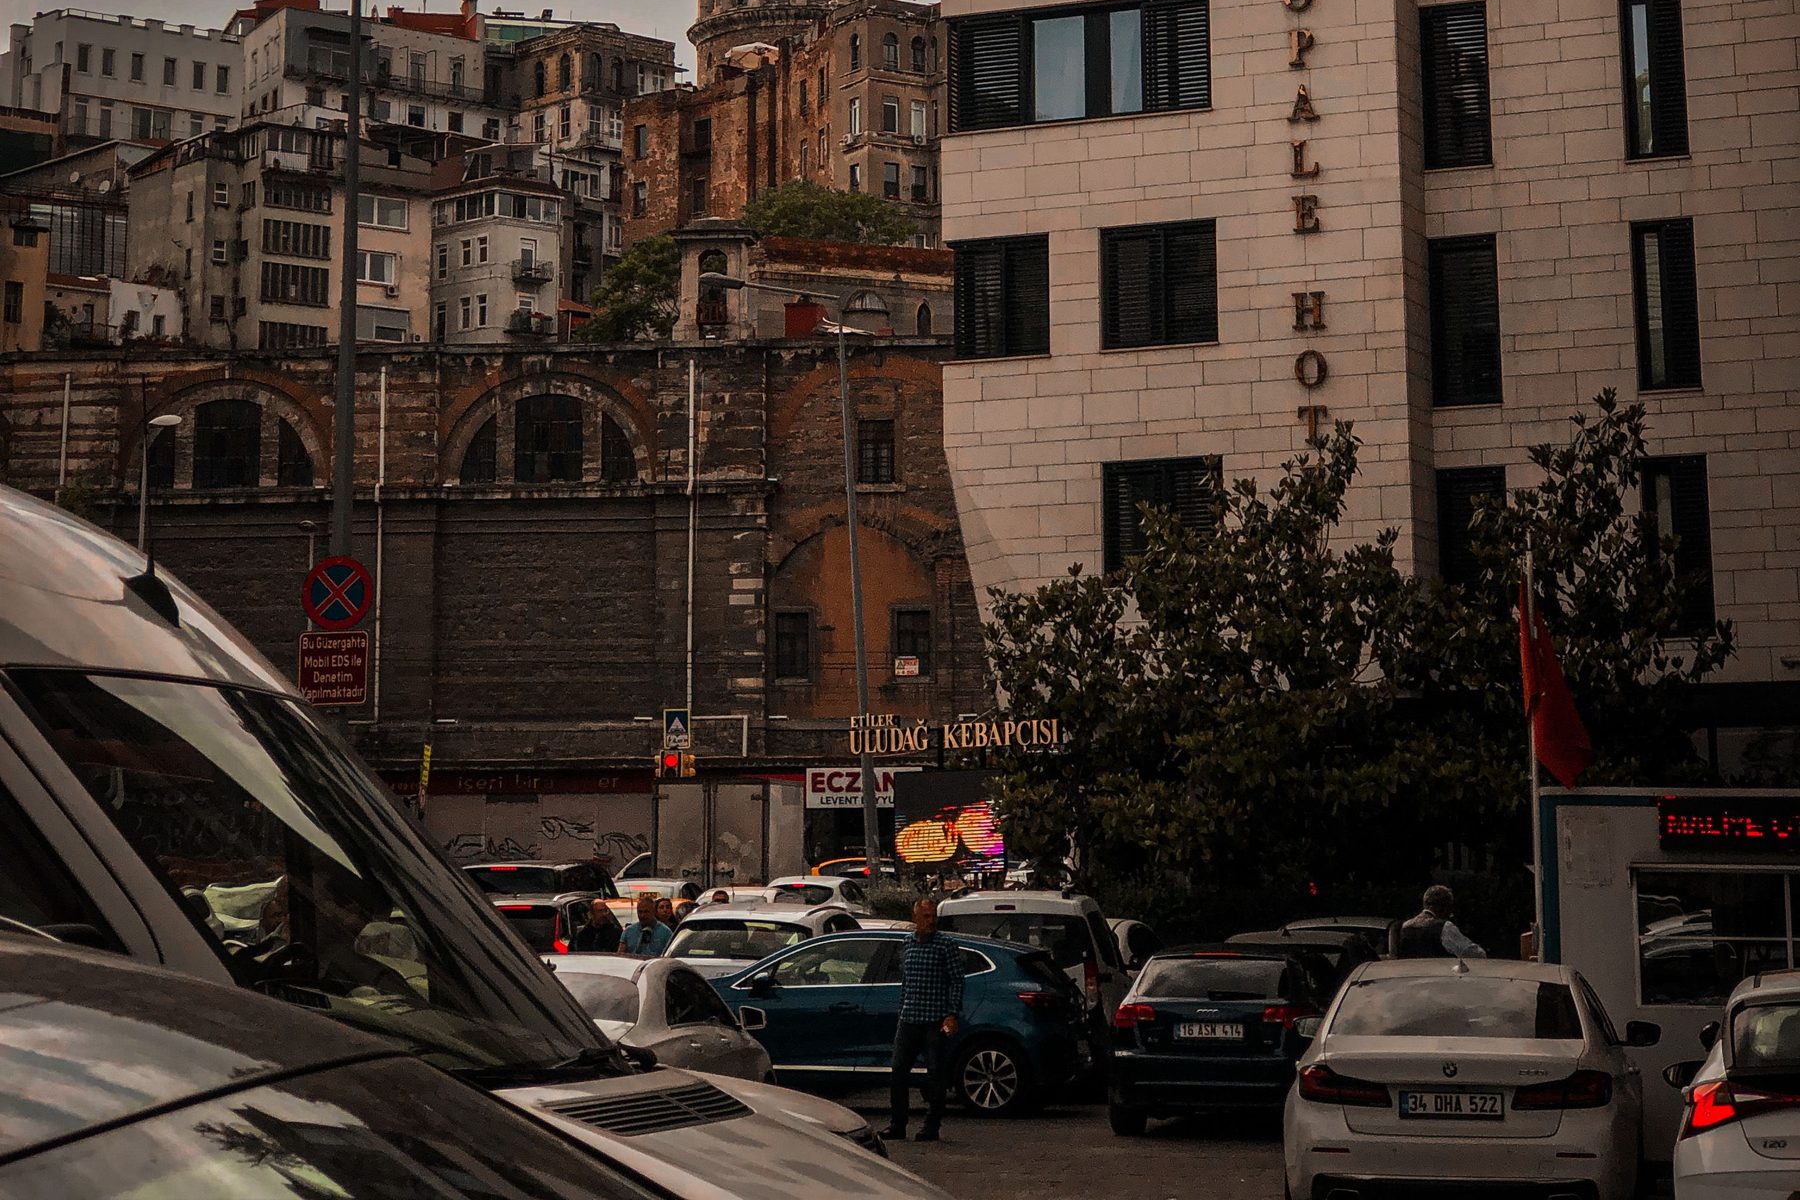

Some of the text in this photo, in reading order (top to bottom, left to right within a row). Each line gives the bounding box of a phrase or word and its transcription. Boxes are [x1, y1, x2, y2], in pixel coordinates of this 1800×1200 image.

[1290, 290, 1329, 472] HOT
[302, 635, 366, 651] Bu Güzergahta
[304, 654, 362, 668] Mobil EDS ile
[313, 671, 353, 683] Denetim
[850, 712, 895, 728] ETİLER
[848, 718, 1059, 755] ULUDAĞ KEBAPÇISI
[811, 771, 895, 793] ECZN
[820, 796, 859, 805] LEVENT
[1181, 1023, 1194, 1036] 16
[1222, 1023, 1241, 1036] 414
[1409, 1094, 1498, 1113] 34 DHA 522
